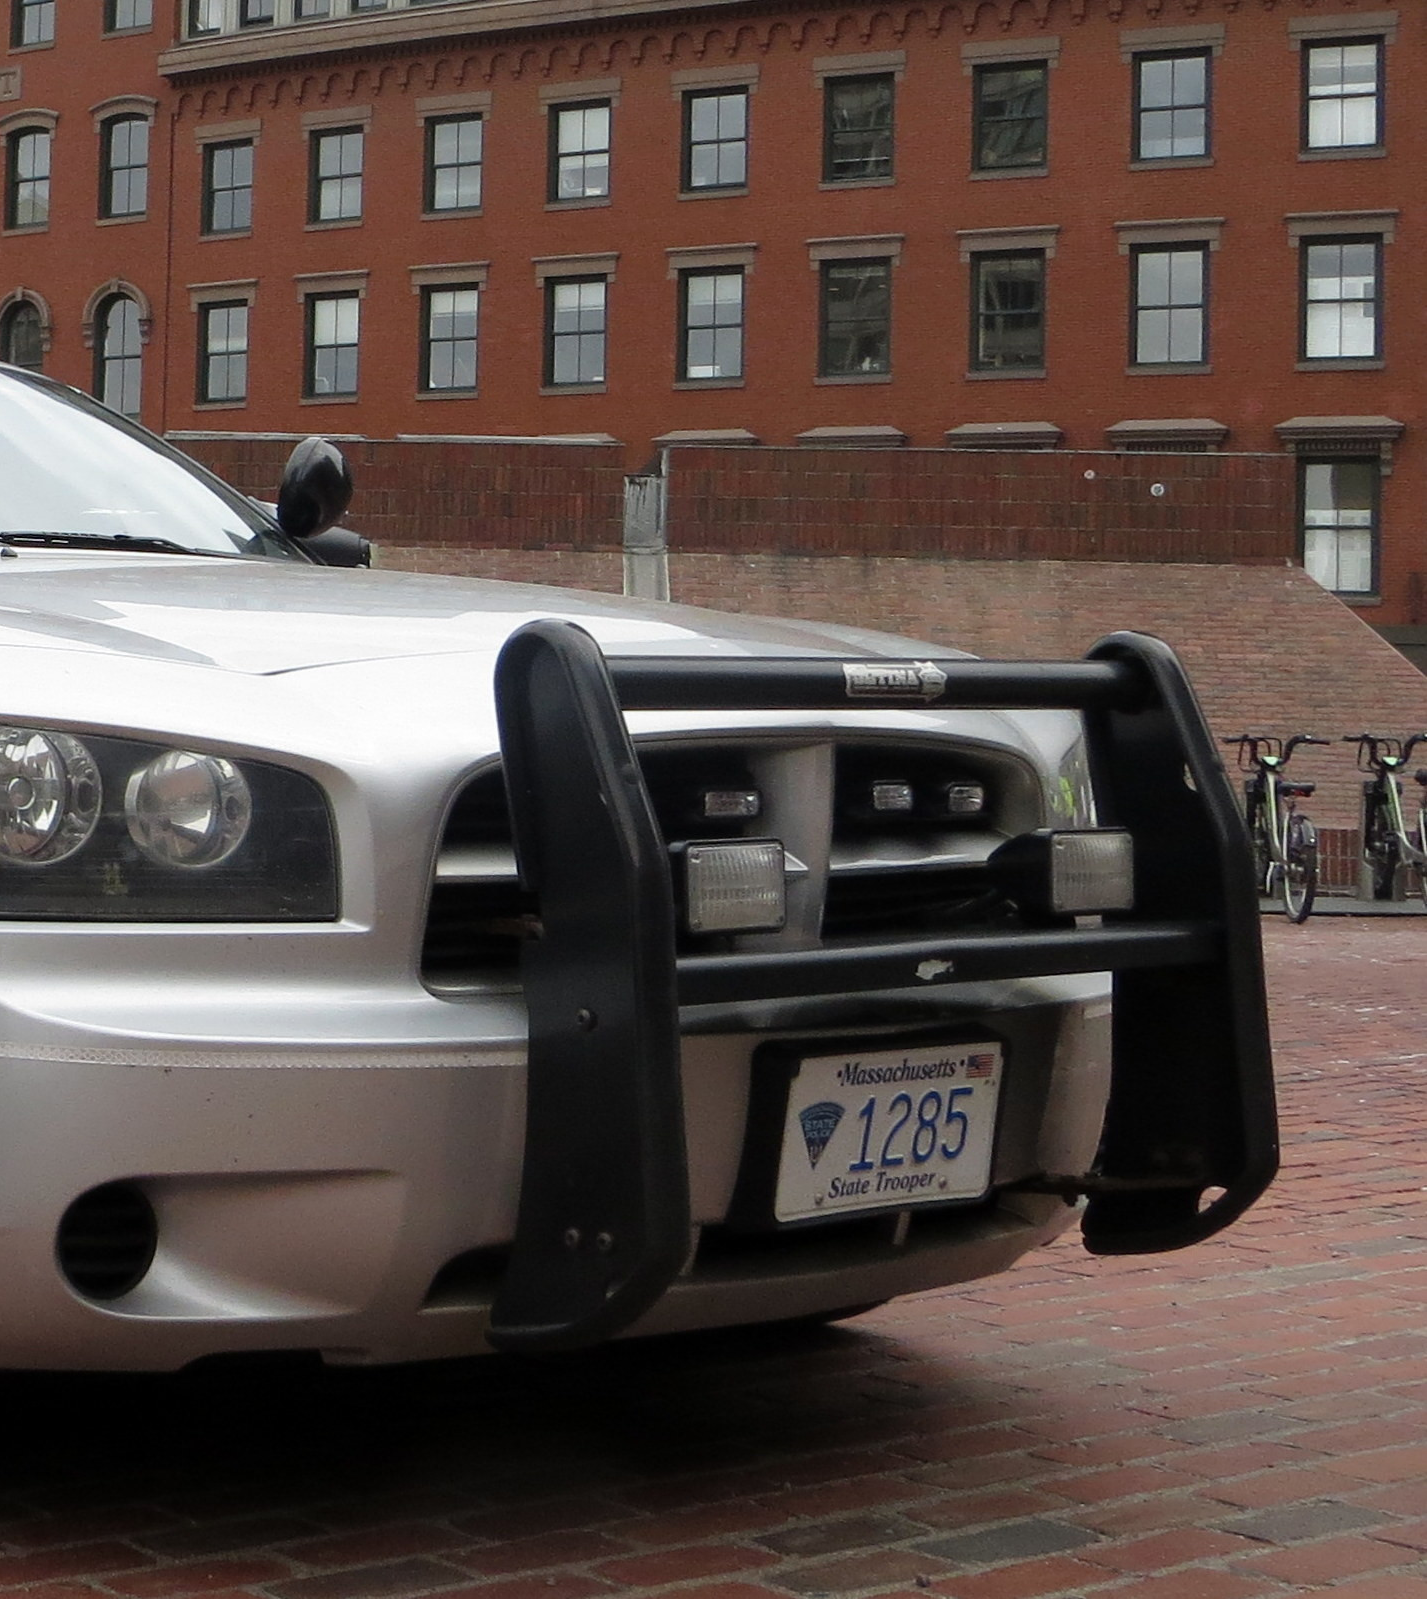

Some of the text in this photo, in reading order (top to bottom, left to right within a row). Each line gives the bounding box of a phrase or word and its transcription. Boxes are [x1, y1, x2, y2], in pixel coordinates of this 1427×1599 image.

[849, 1086, 973, 1171] 1285
[828, 1171, 936, 1199] State Trooper
